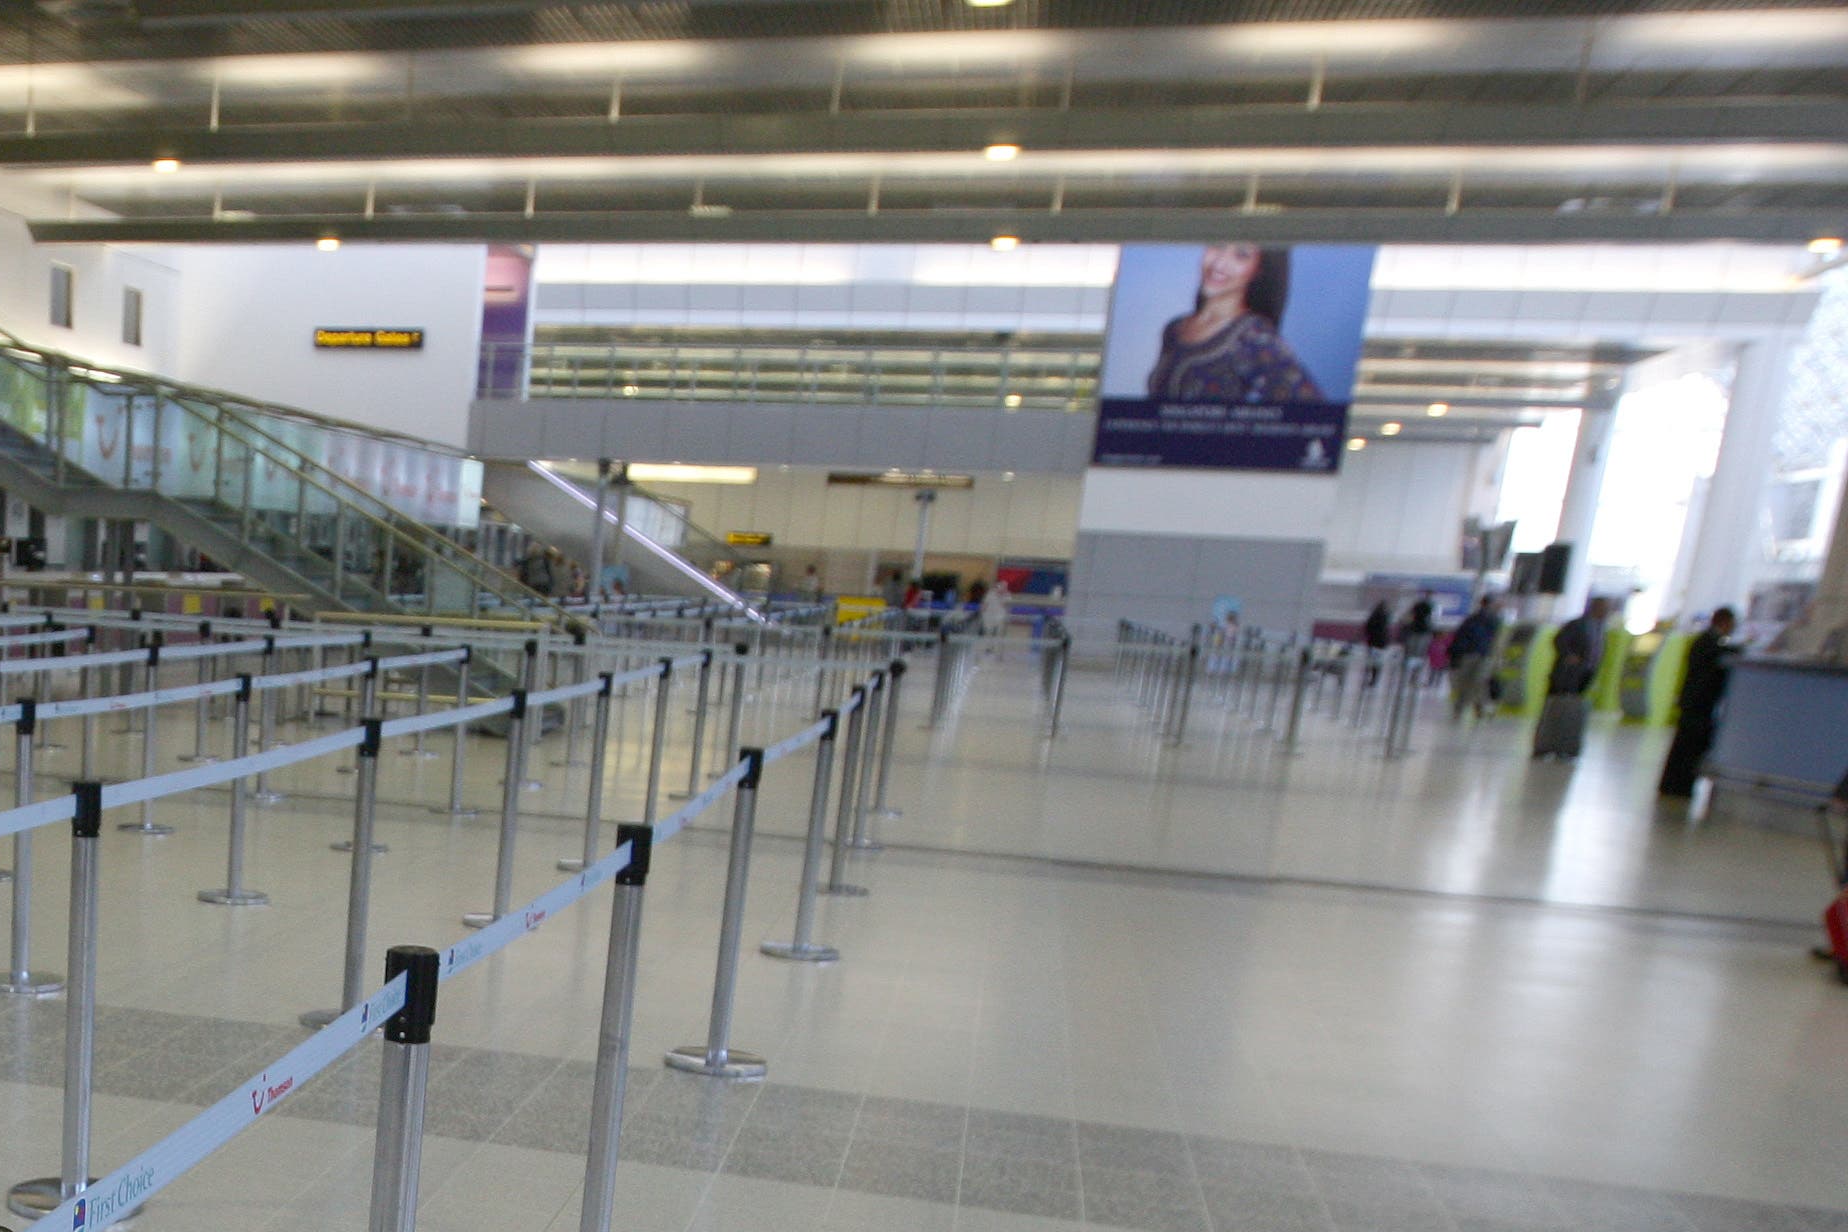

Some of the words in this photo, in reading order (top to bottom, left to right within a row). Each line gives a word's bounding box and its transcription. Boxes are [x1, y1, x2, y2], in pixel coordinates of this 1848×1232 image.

[267, 1075, 294, 1103] Thomson
[89, 1192, 117, 1229] First
[117, 1164, 155, 1207] Choice
